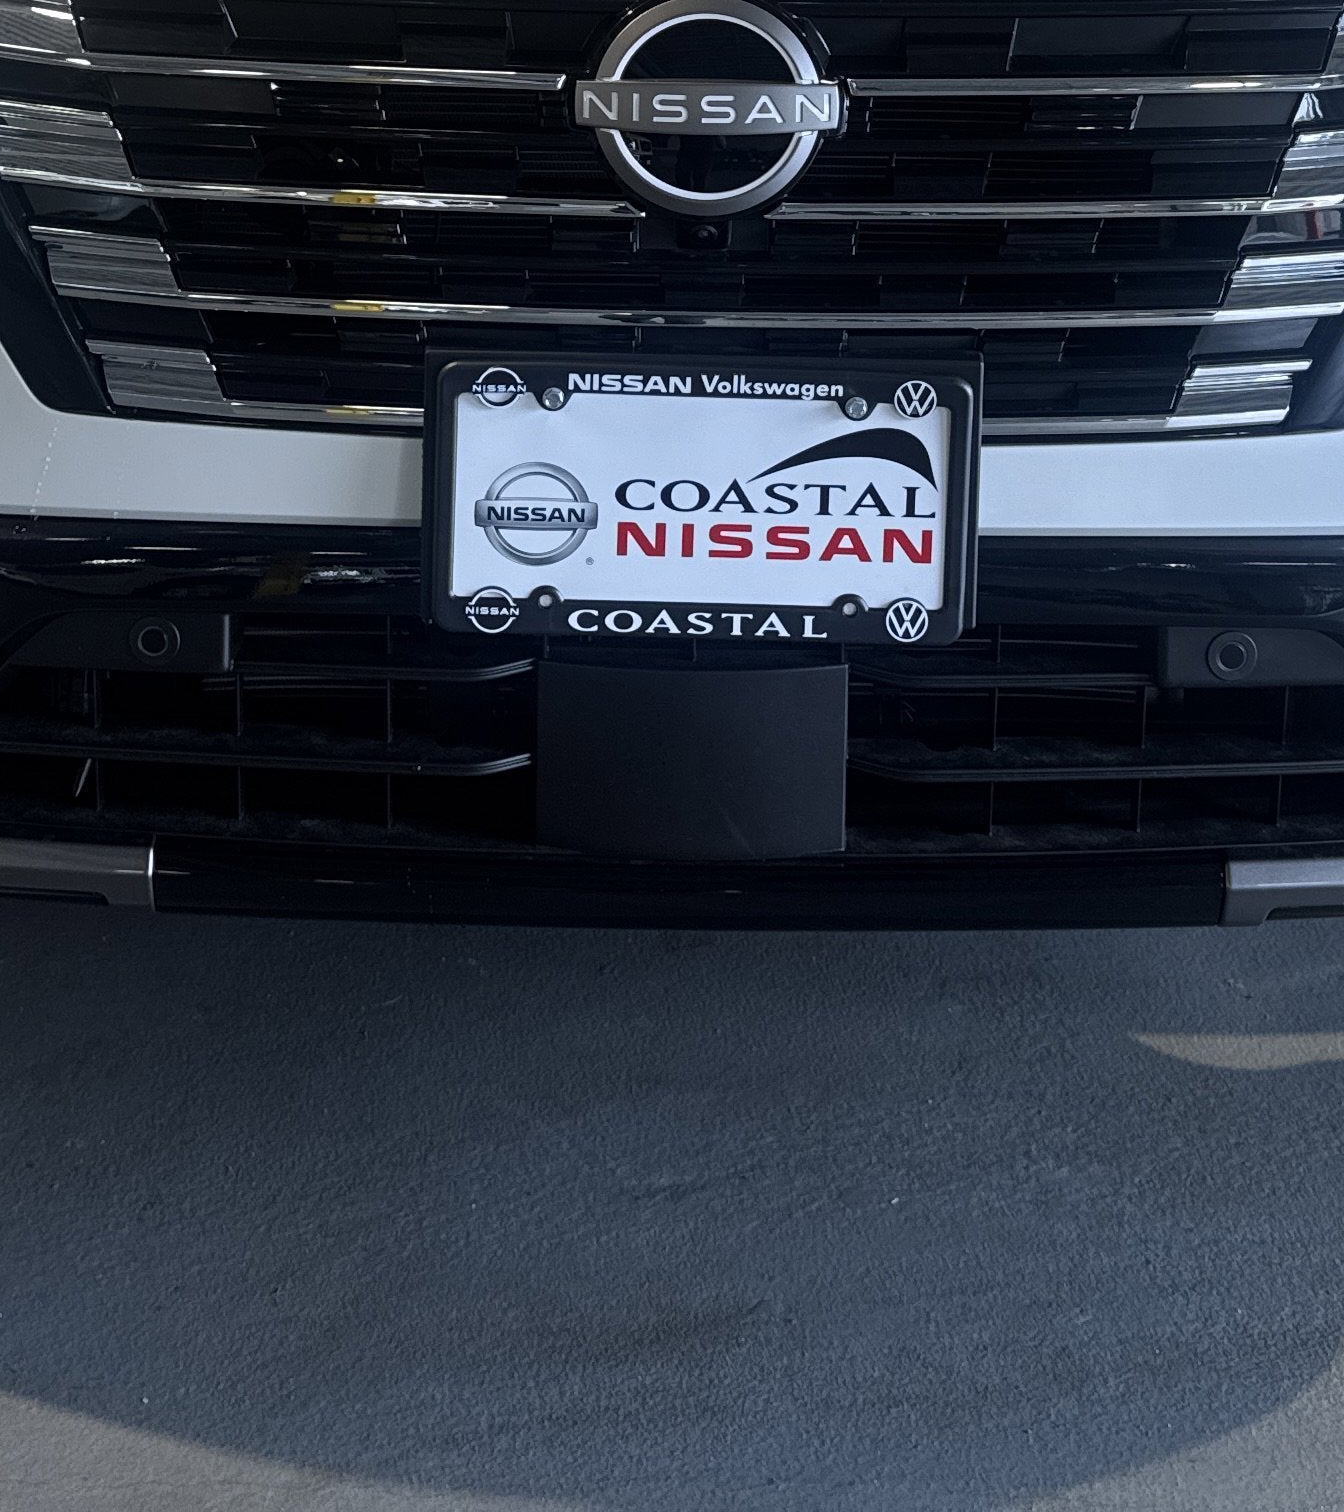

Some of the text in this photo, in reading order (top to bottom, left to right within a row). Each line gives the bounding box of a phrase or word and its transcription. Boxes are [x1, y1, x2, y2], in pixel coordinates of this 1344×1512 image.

[582, 90, 831, 124] NISSAN
[472, 383, 527, 393] NISSAN
[568, 373, 844, 400] NISSAN Volkswagen
[615, 478, 936, 518] COASTAL
[487, 506, 586, 523] NISSAN
[617, 522, 932, 563] NISSAN
[465, 606, 520, 617] NISSAN
[568, 609, 827, 638] COASTAL
